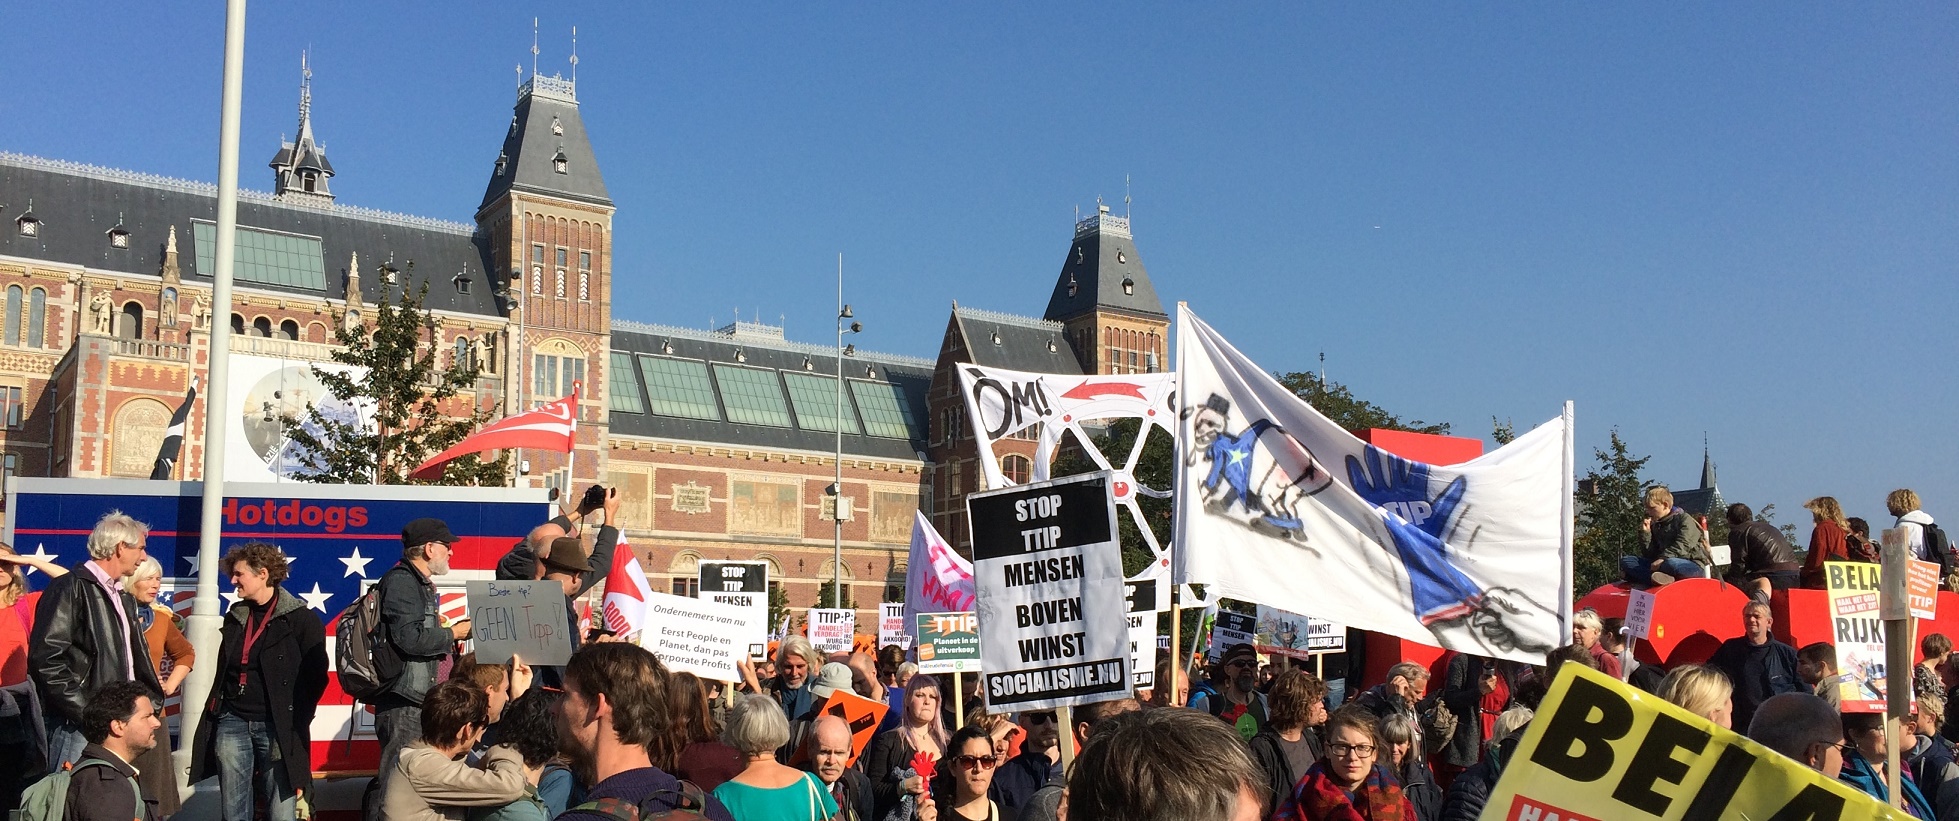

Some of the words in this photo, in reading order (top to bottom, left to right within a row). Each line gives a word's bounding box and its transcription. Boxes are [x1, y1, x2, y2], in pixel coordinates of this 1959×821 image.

[222, 499, 368, 533] Hotdogs
[1015, 494, 1062, 522] STOP
[1382, 501, 1432, 525] TIP
[1021, 525, 1062, 552] TTIP
[722, 567, 746, 578] STOP
[1004, 554, 1085, 588] MENSEN
[723, 581, 744, 592] TTIP
[1124, 585, 1136, 597] OP
[714, 596, 752, 607] MENSEN
[1126, 600, 1134, 612] IP
[654, 604, 714, 622] Ondernemers
[716, 616, 732, 624] van
[734, 619, 746, 627] nu
[818, 612, 844, 624] TTIP:
[1016, 597, 1083, 629] BOVEN
[1230, 615, 1244, 623] STOP
[475, 606, 517, 642] GEEN
[933, 616, 977, 633] TTIP
[1127, 616, 1143, 628] SEN
[1308, 624, 1331, 634] WINST
[661, 627, 684, 638] Eerst
[687, 630, 718, 643] People
[934, 637, 961, 645] Planeet
[1222, 629, 1246, 640] MENSEN
[659, 639, 692, 652] Planet,
[693, 645, 711, 655] dan
[713, 650, 729, 658] pas
[1018, 632, 1086, 663] WINST
[654, 651, 699, 666] Corporate
[701, 658, 731, 670] Profits
[991, 661, 1120, 697] SOCIALISME.NU
